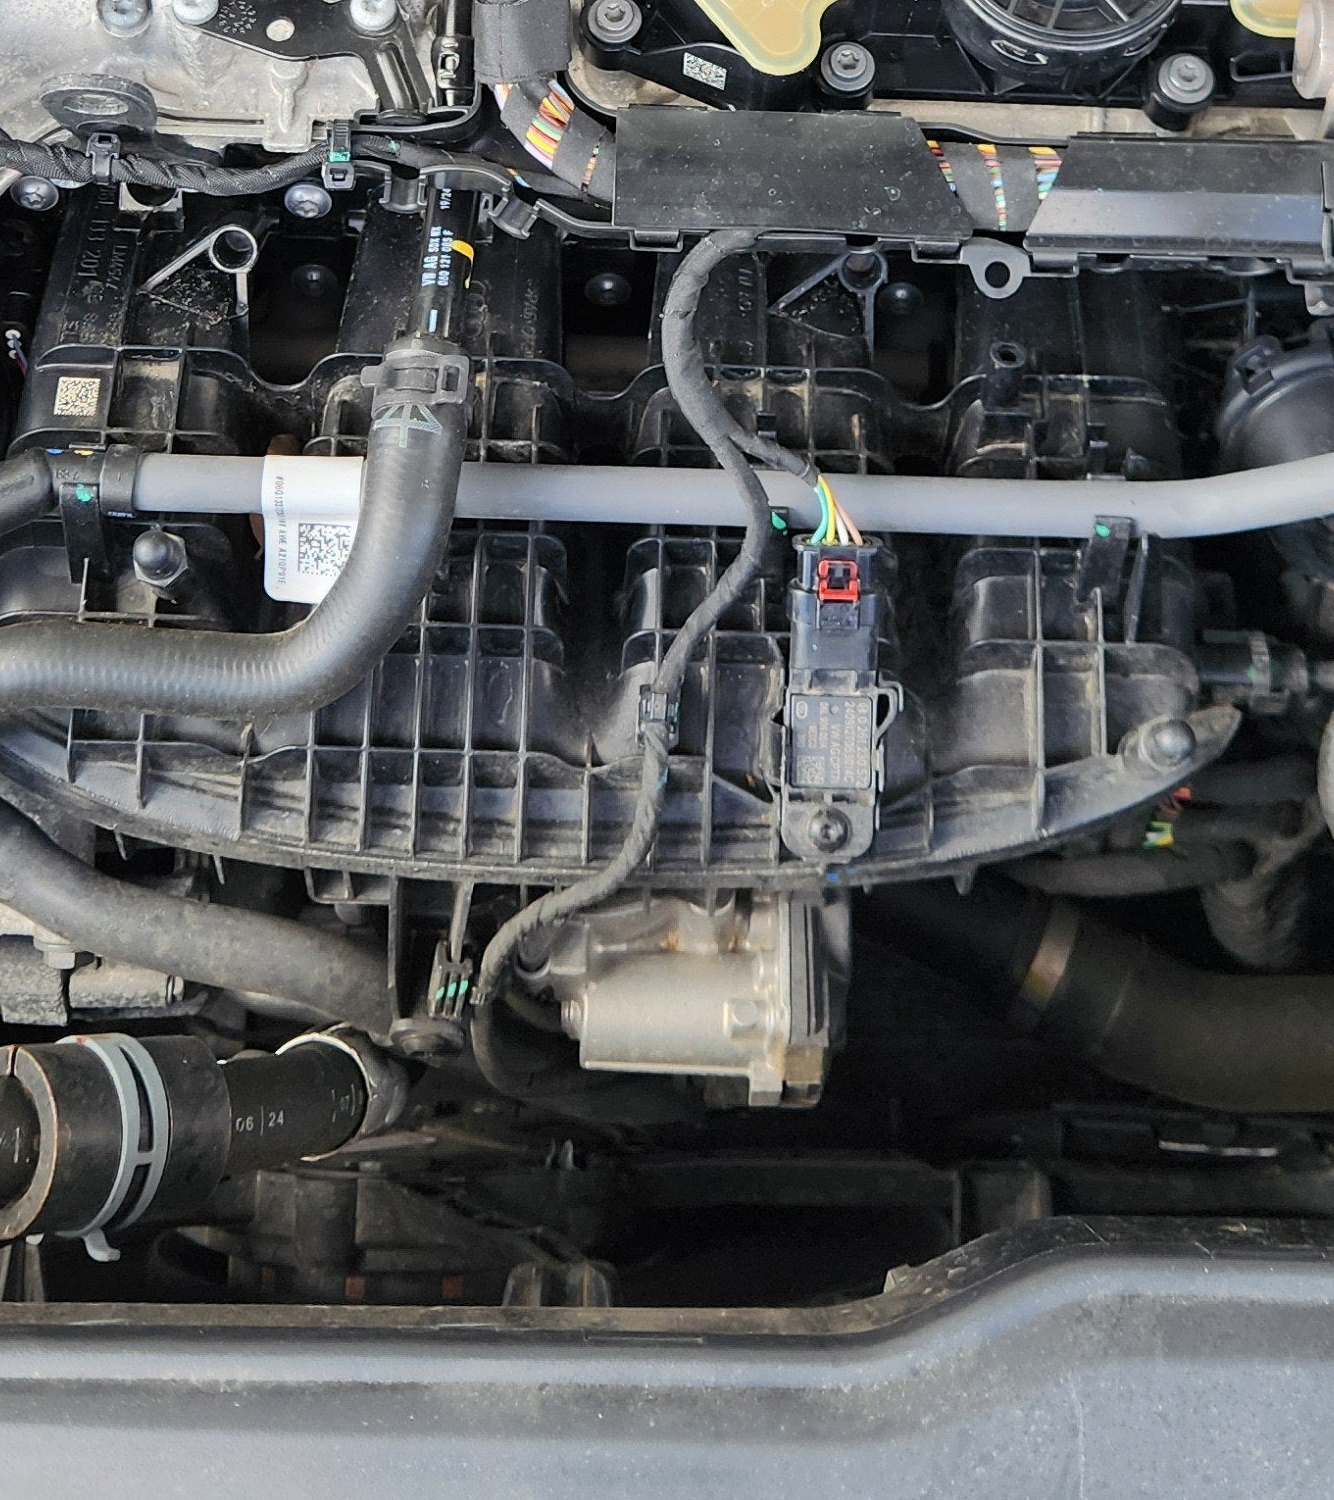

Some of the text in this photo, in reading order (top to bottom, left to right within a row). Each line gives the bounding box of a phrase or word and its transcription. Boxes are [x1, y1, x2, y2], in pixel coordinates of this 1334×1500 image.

[423, 255, 439, 270] AG
[235, 1109, 284, 1133] 06 24
